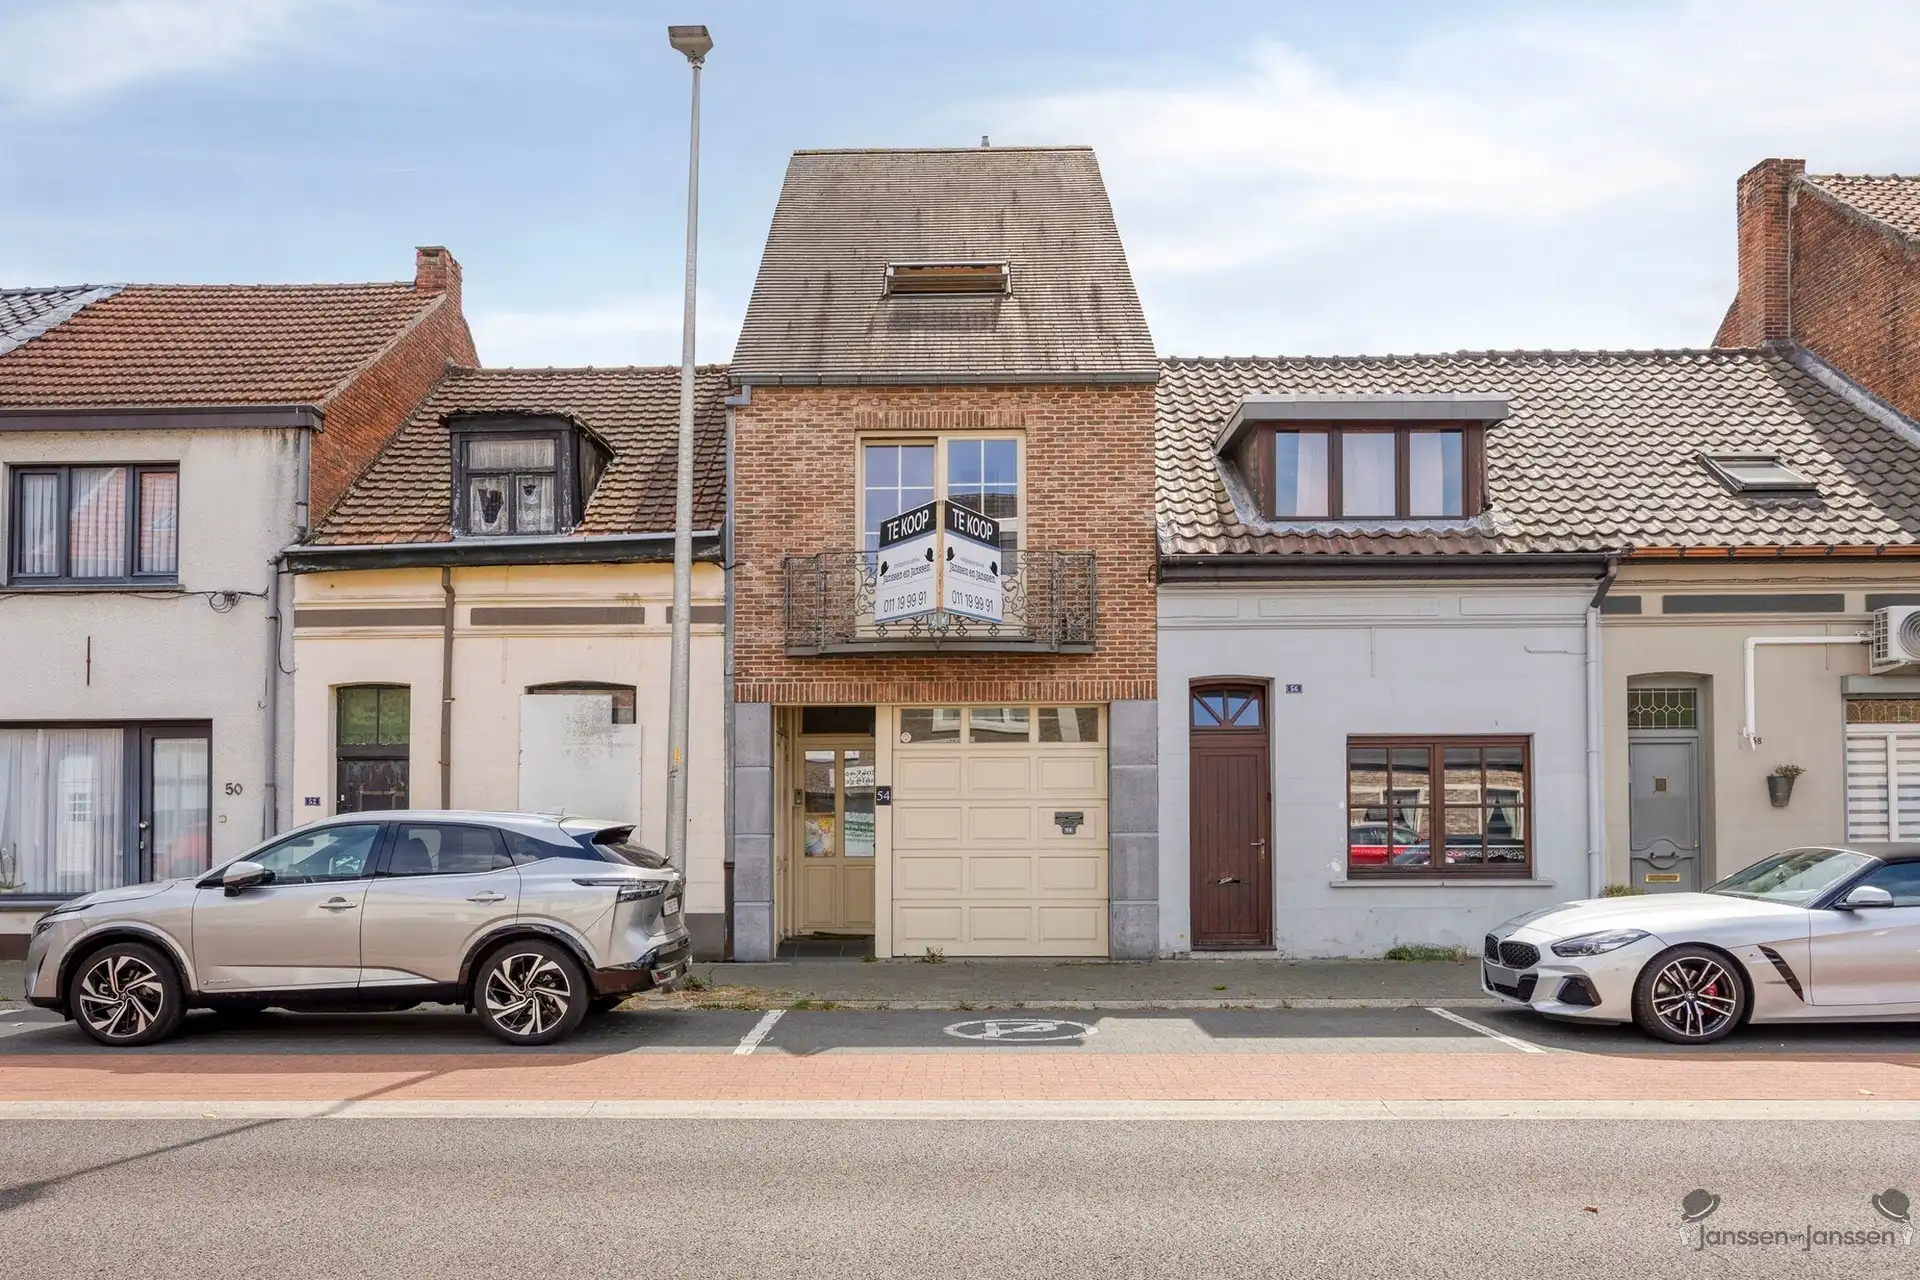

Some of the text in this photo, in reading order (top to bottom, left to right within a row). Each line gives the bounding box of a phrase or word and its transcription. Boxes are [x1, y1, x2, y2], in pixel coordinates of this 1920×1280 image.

[887, 509, 929, 541] TE KOOP
[952, 508, 993, 540] TE KOOP
[884, 591, 927, 612] 011 19 99 91
[952, 590, 994, 613] 011 19 99 91
[225, 782, 243, 795] 50
[876, 790, 891, 801] 54
